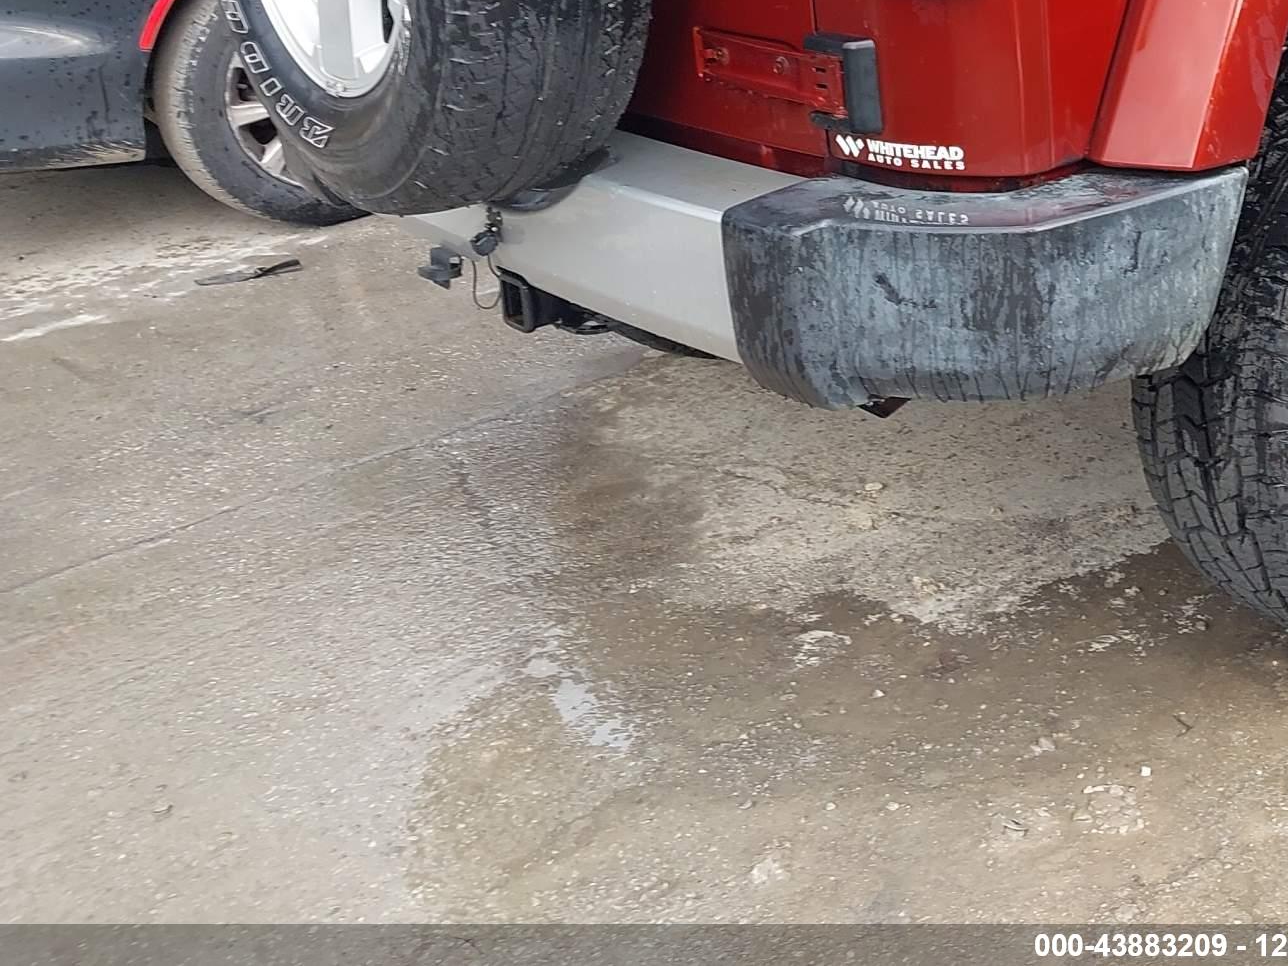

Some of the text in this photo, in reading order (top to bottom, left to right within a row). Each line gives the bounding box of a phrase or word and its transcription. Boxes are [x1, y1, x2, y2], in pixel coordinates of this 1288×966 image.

[866, 138, 964, 161] WHITEHEAD
[868, 153, 966, 171] AUTO SALES
